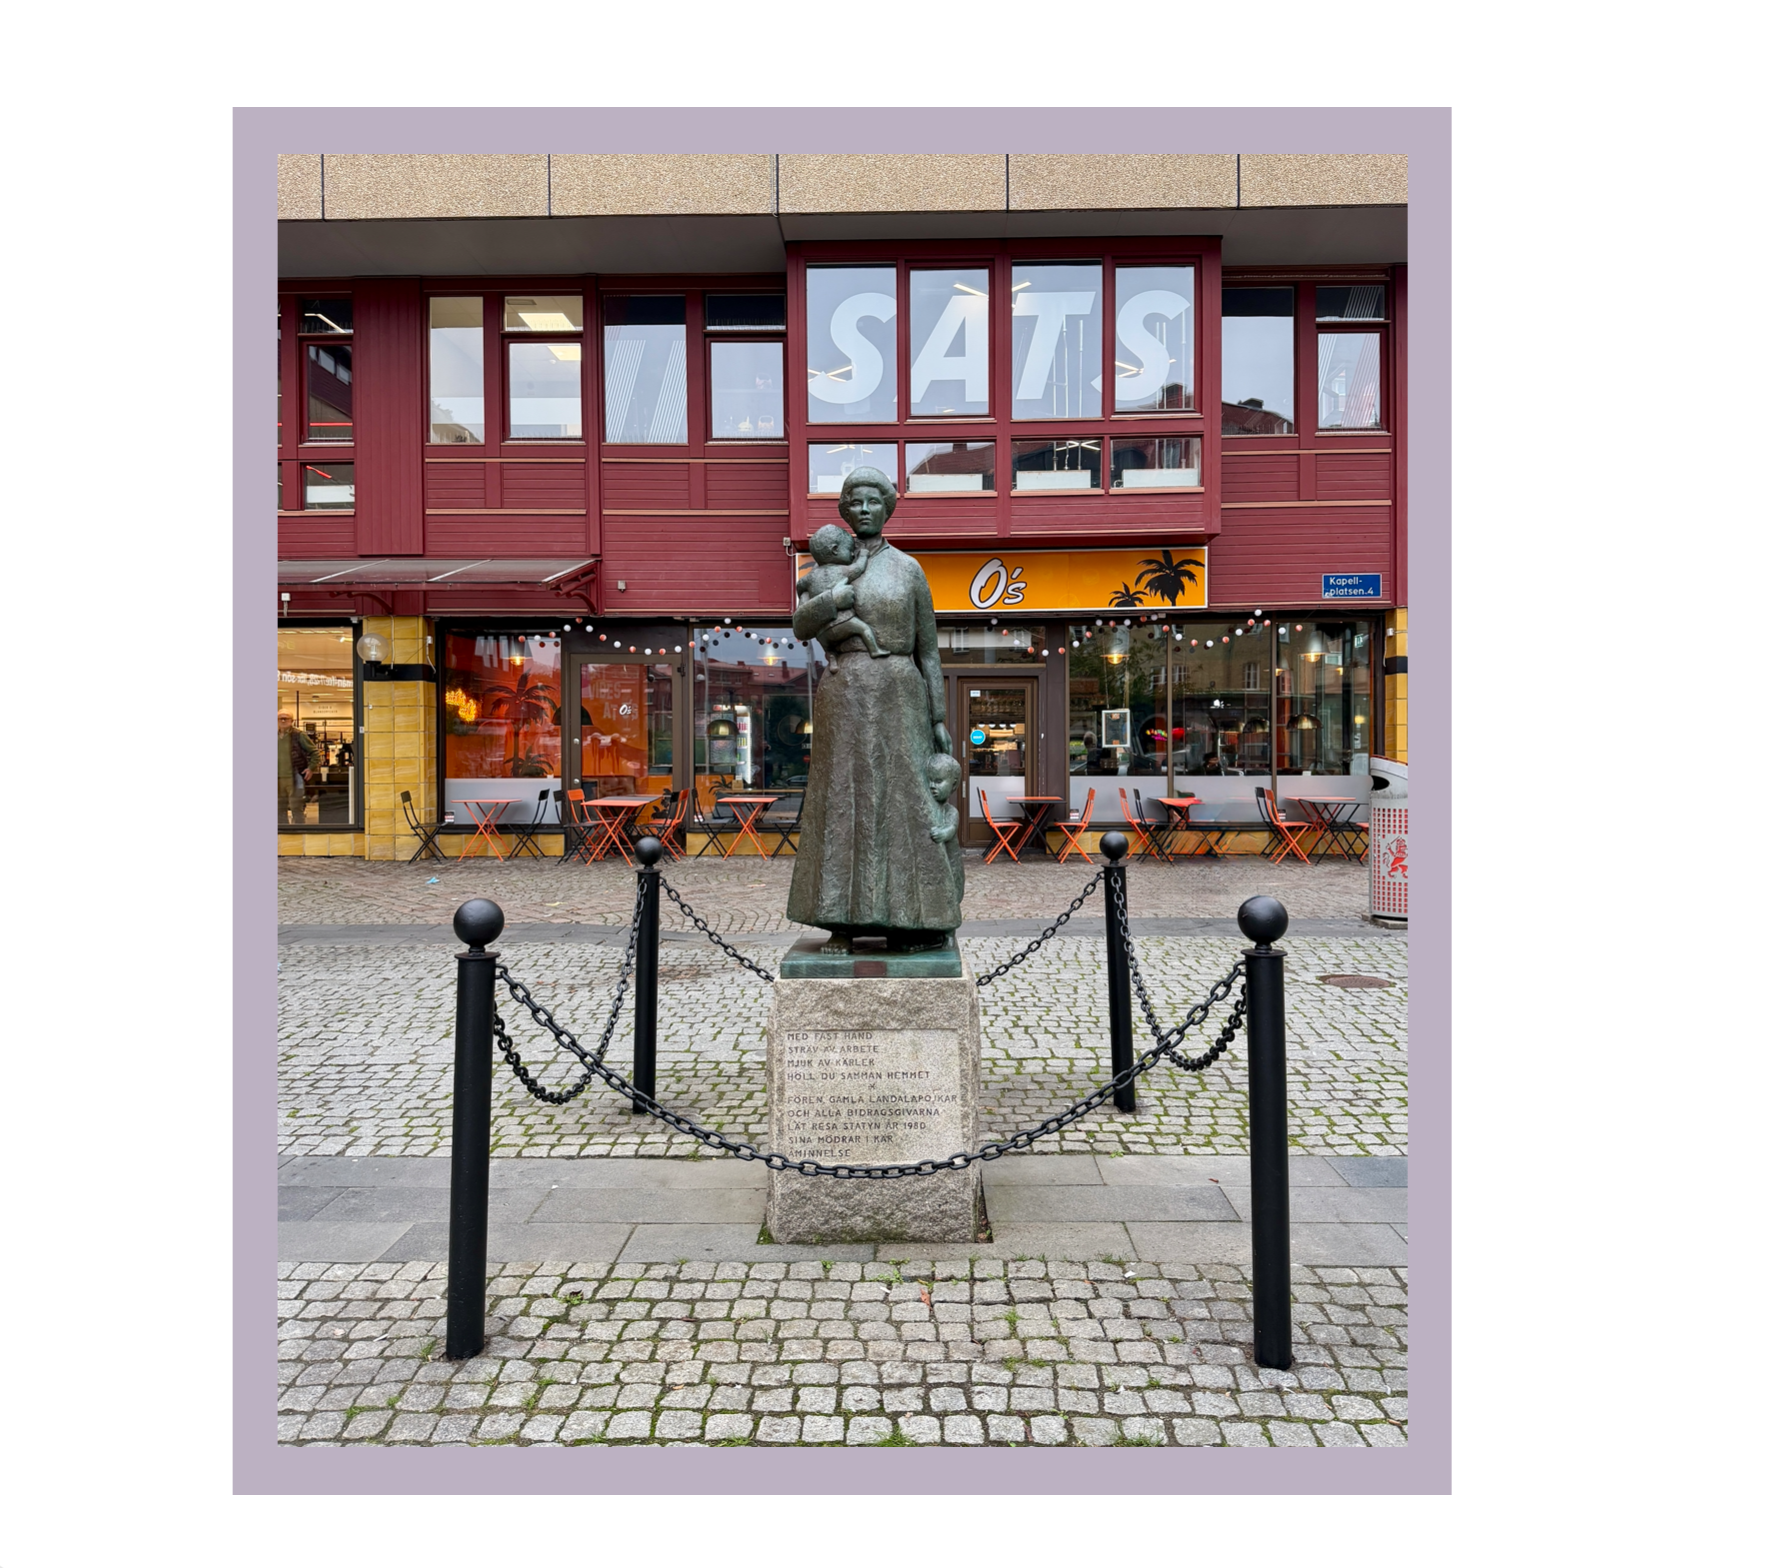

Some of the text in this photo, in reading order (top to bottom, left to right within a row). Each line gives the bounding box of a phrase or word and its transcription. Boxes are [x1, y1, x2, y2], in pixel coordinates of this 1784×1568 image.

[807, 289, 1191, 404] SATS
[969, 557, 1027, 609] O's
[1329, 576, 1363, 586] Kapell-
[814, 1032, 838, 1040] FAST
[844, 1032, 873, 1040] HAND
[788, 1045, 818, 1053] STRÄV
[840, 1045, 879, 1053] ARBETE
[787, 1072, 815, 1080] HÖLL
[821, 1072, 836, 1080] DU
[887, 1071, 930, 1079] HEMMET
[829, 1096, 864, 1104] GAMLA
[787, 1108, 940, 1118] OCH ALLA BIDRAGSGIVARNA
[812, 1122, 838, 1131] RESA
[843, 1122, 880, 1130] STATYN
[904, 1122, 926, 1130] 1980
[788, 1136, 812, 1144] SINA
[817, 1134, 861, 1144] MÖDRAR
